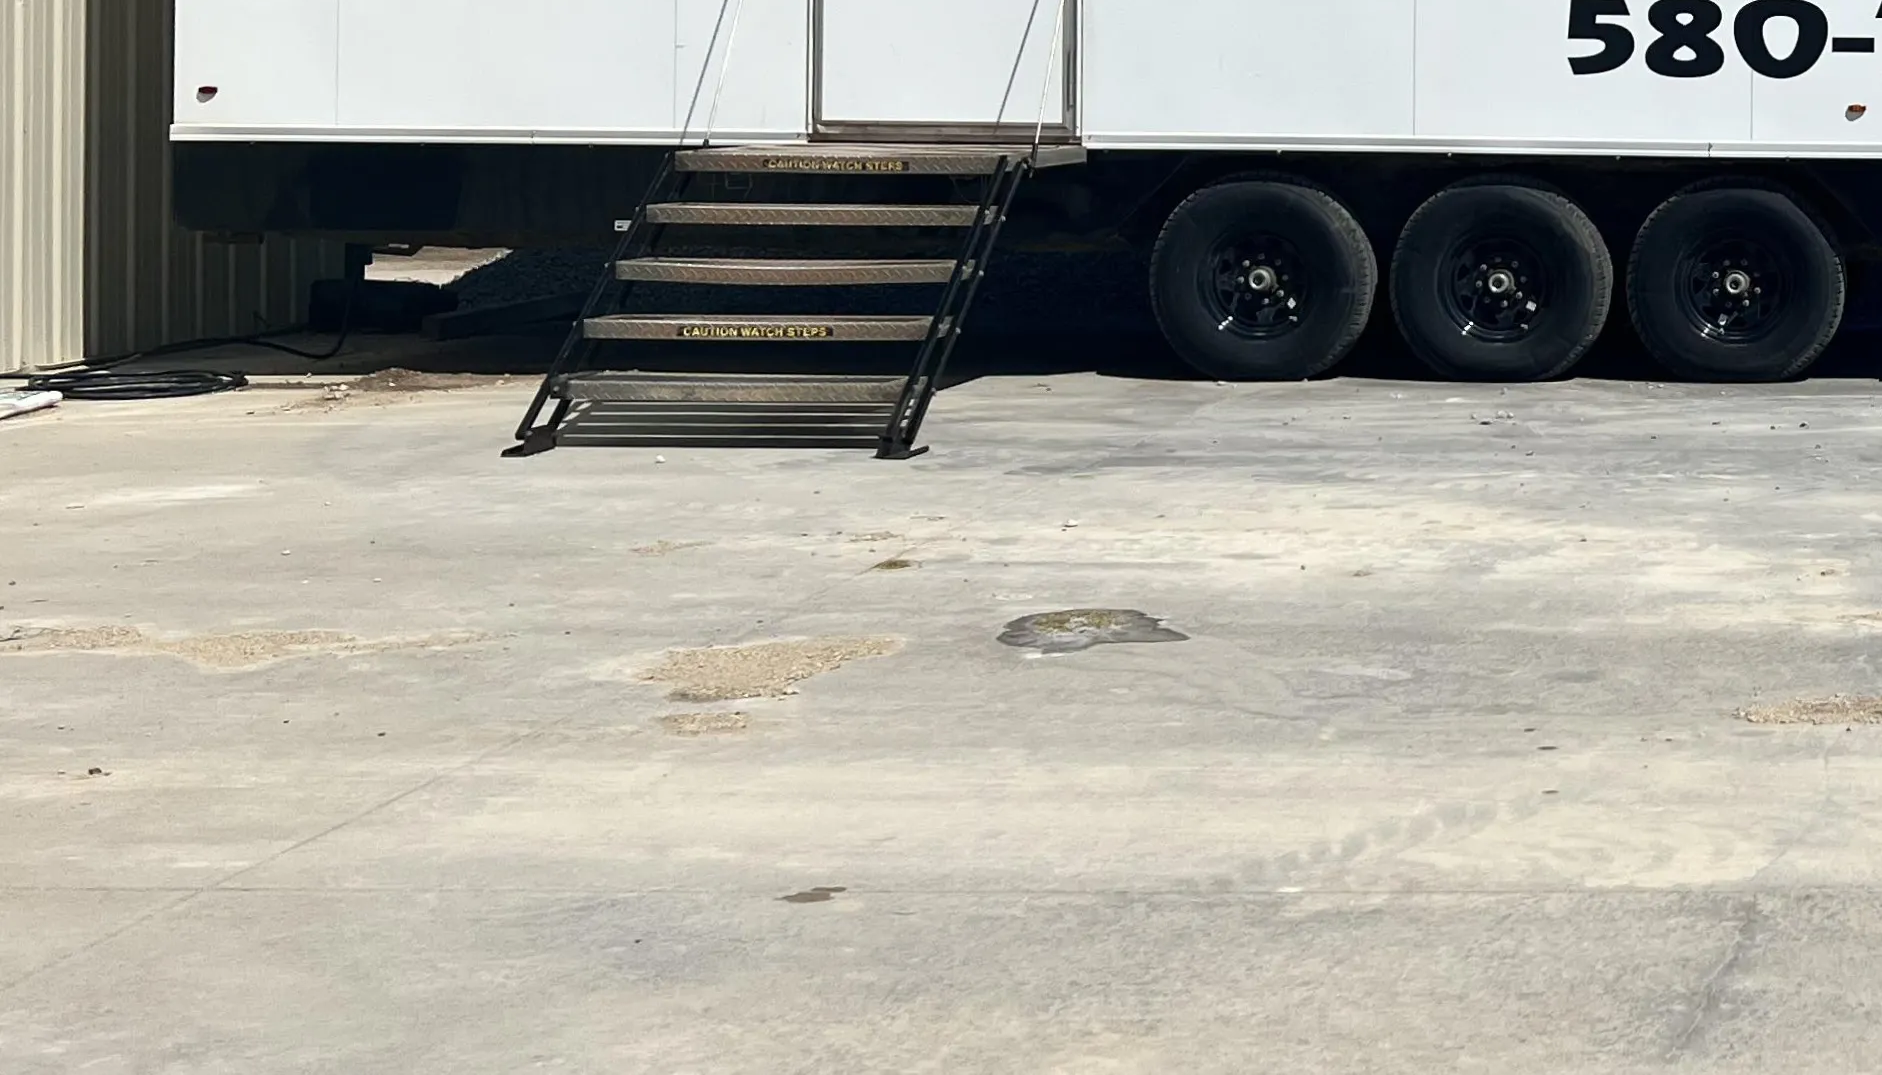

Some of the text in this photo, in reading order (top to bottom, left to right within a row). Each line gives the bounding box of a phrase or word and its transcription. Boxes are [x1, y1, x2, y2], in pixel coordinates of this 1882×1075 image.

[822, 161, 863, 170] WATCH
[684, 327, 826, 337] CAUTION WATCH STEPS
